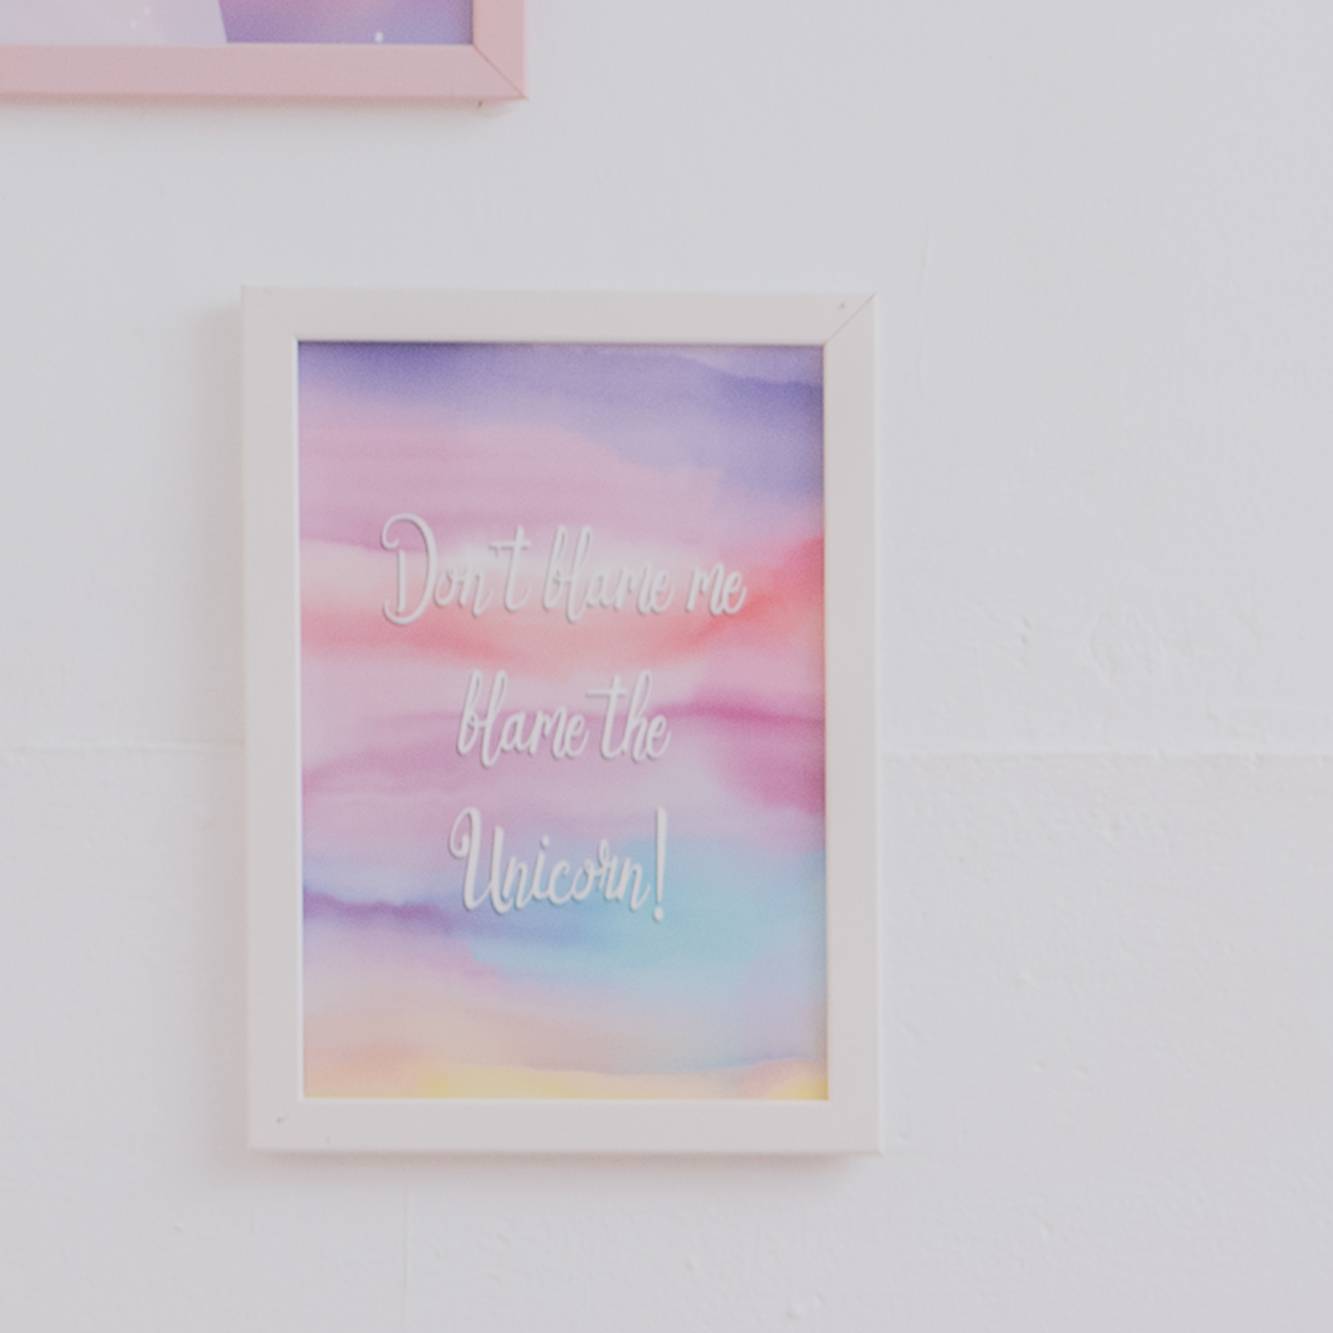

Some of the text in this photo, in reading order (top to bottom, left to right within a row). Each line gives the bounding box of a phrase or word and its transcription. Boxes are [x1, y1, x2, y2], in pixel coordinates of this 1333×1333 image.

[541, 525, 674, 623] blame
[684, 561, 748, 616] me
[456, 669, 672, 769] blame the
[448, 805, 668, 923] Unicorn!
